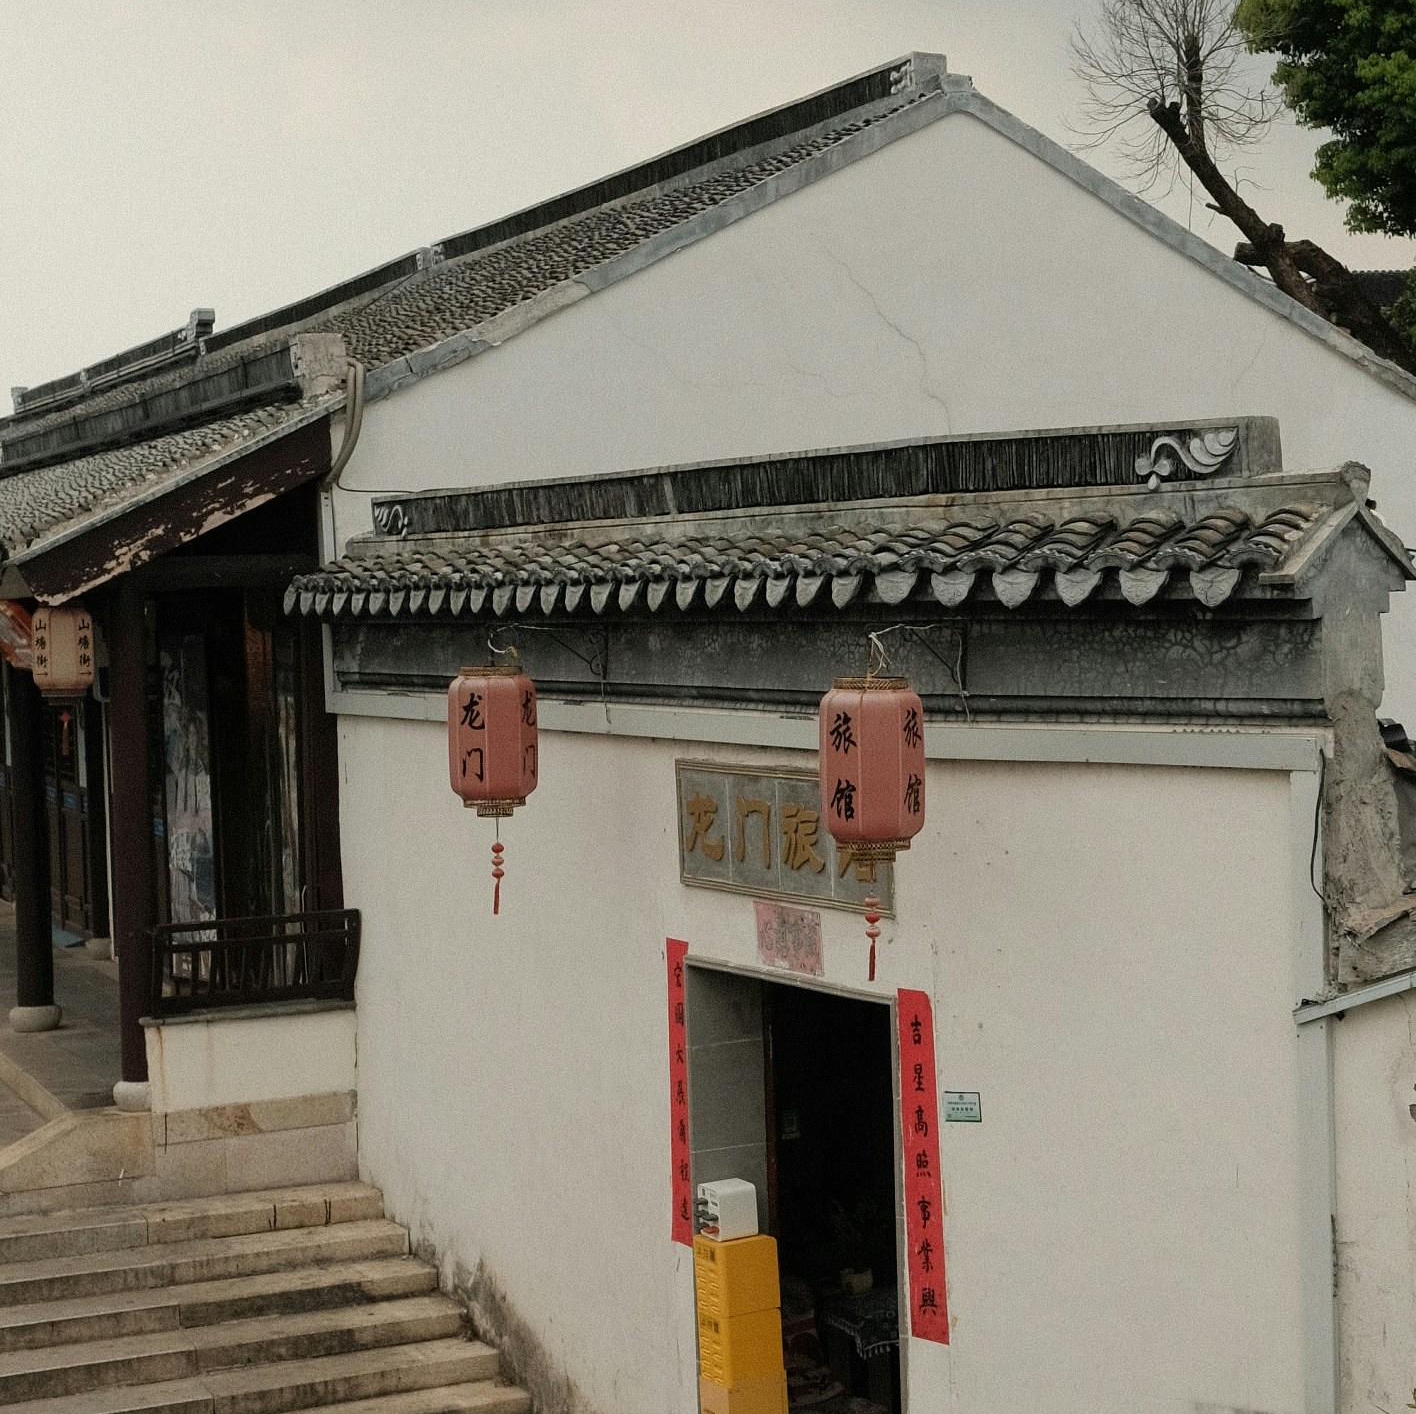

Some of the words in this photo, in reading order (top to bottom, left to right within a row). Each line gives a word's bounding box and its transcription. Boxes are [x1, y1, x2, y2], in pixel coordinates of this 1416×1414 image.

[35, 618, 48, 667] 山塘街
[78, 618, 91, 667] 山塘街
[461, 692, 485, 783] 龙门
[521, 689, 537, 779] 龙门
[829, 711, 858, 823] 旅馆
[903, 707, 922, 816] 旅馆
[909, 1013, 938, 1317] 吉星高照事業興
